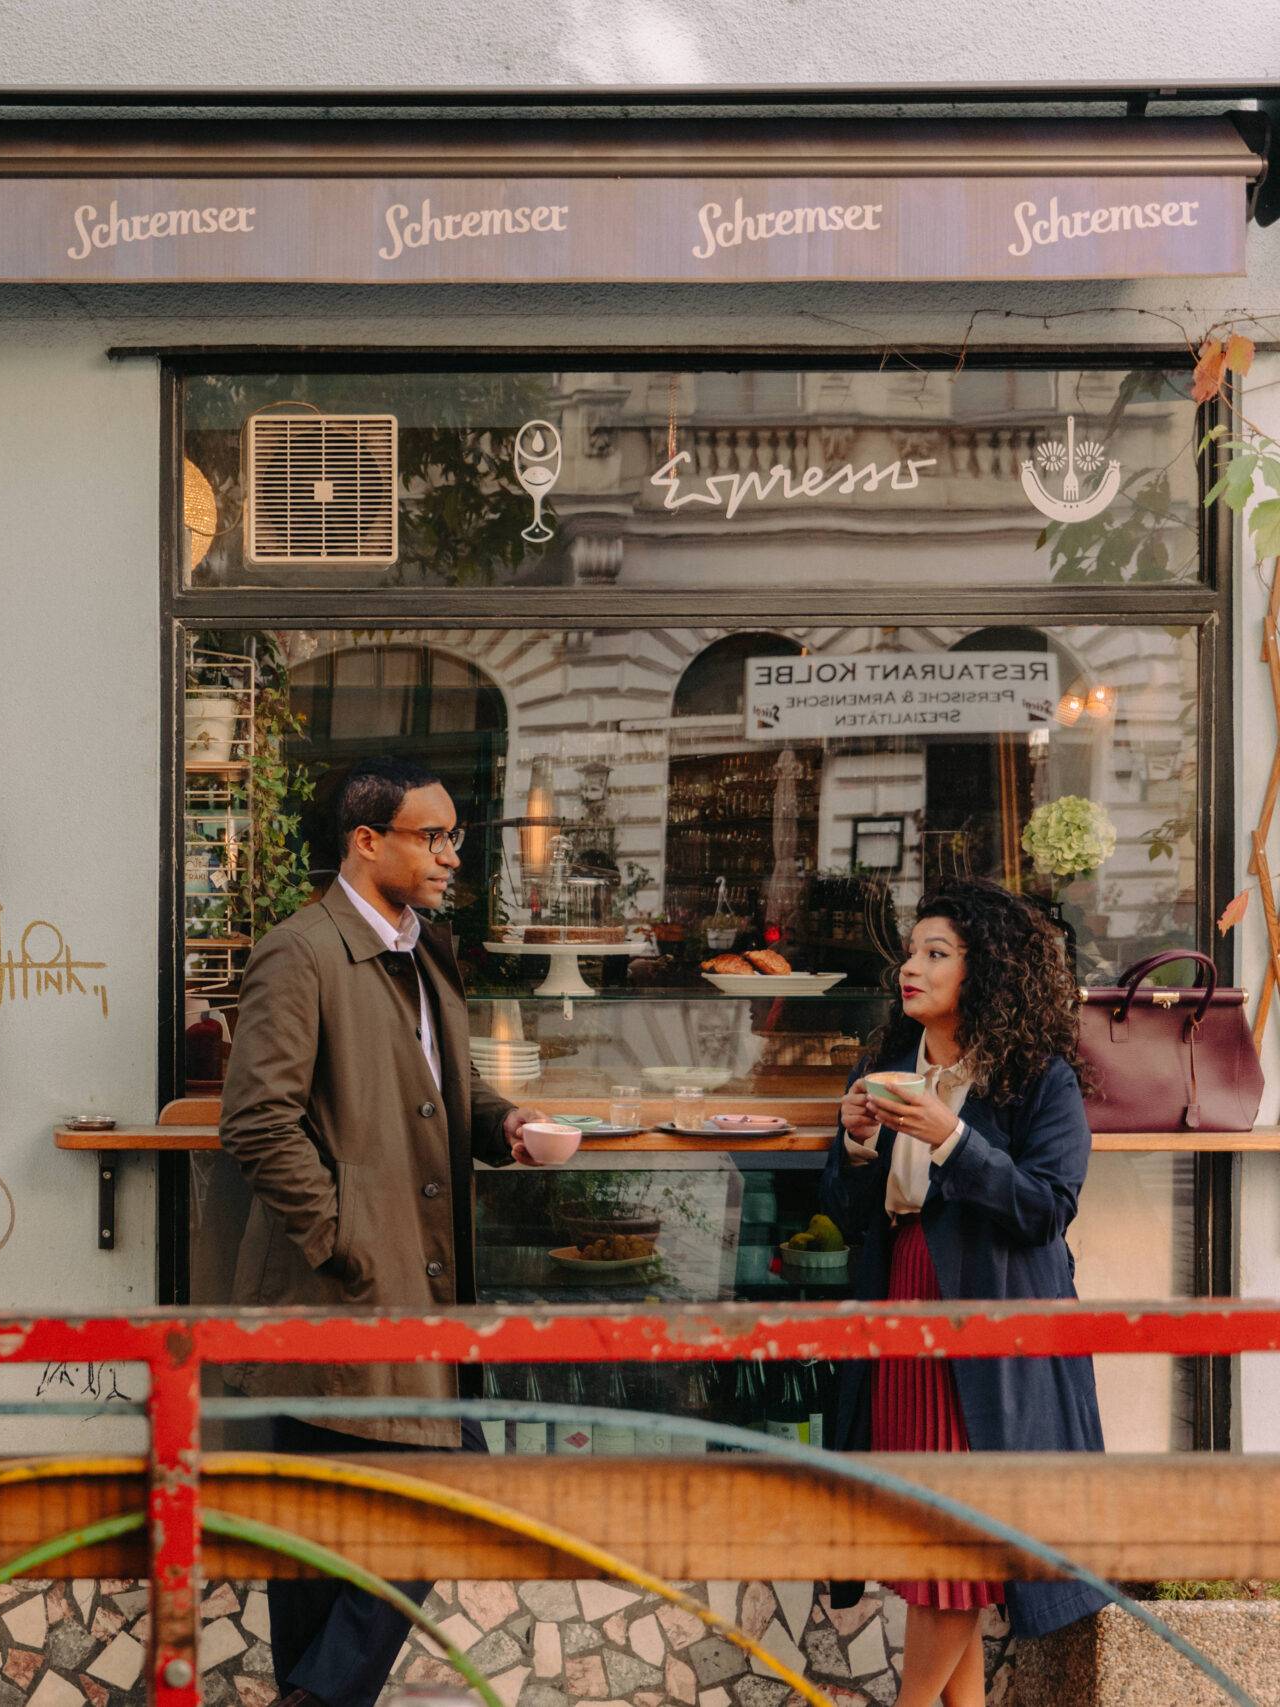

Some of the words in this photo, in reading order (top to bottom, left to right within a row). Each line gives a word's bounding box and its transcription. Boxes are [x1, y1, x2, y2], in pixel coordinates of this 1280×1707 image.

[67, 200, 256, 260] Schremser
[378, 198, 568, 260] Schremser
[692, 197, 883, 260] Schremser
[1007, 196, 1200, 256] Schremser
[650, 450, 938, 519] Espresso
